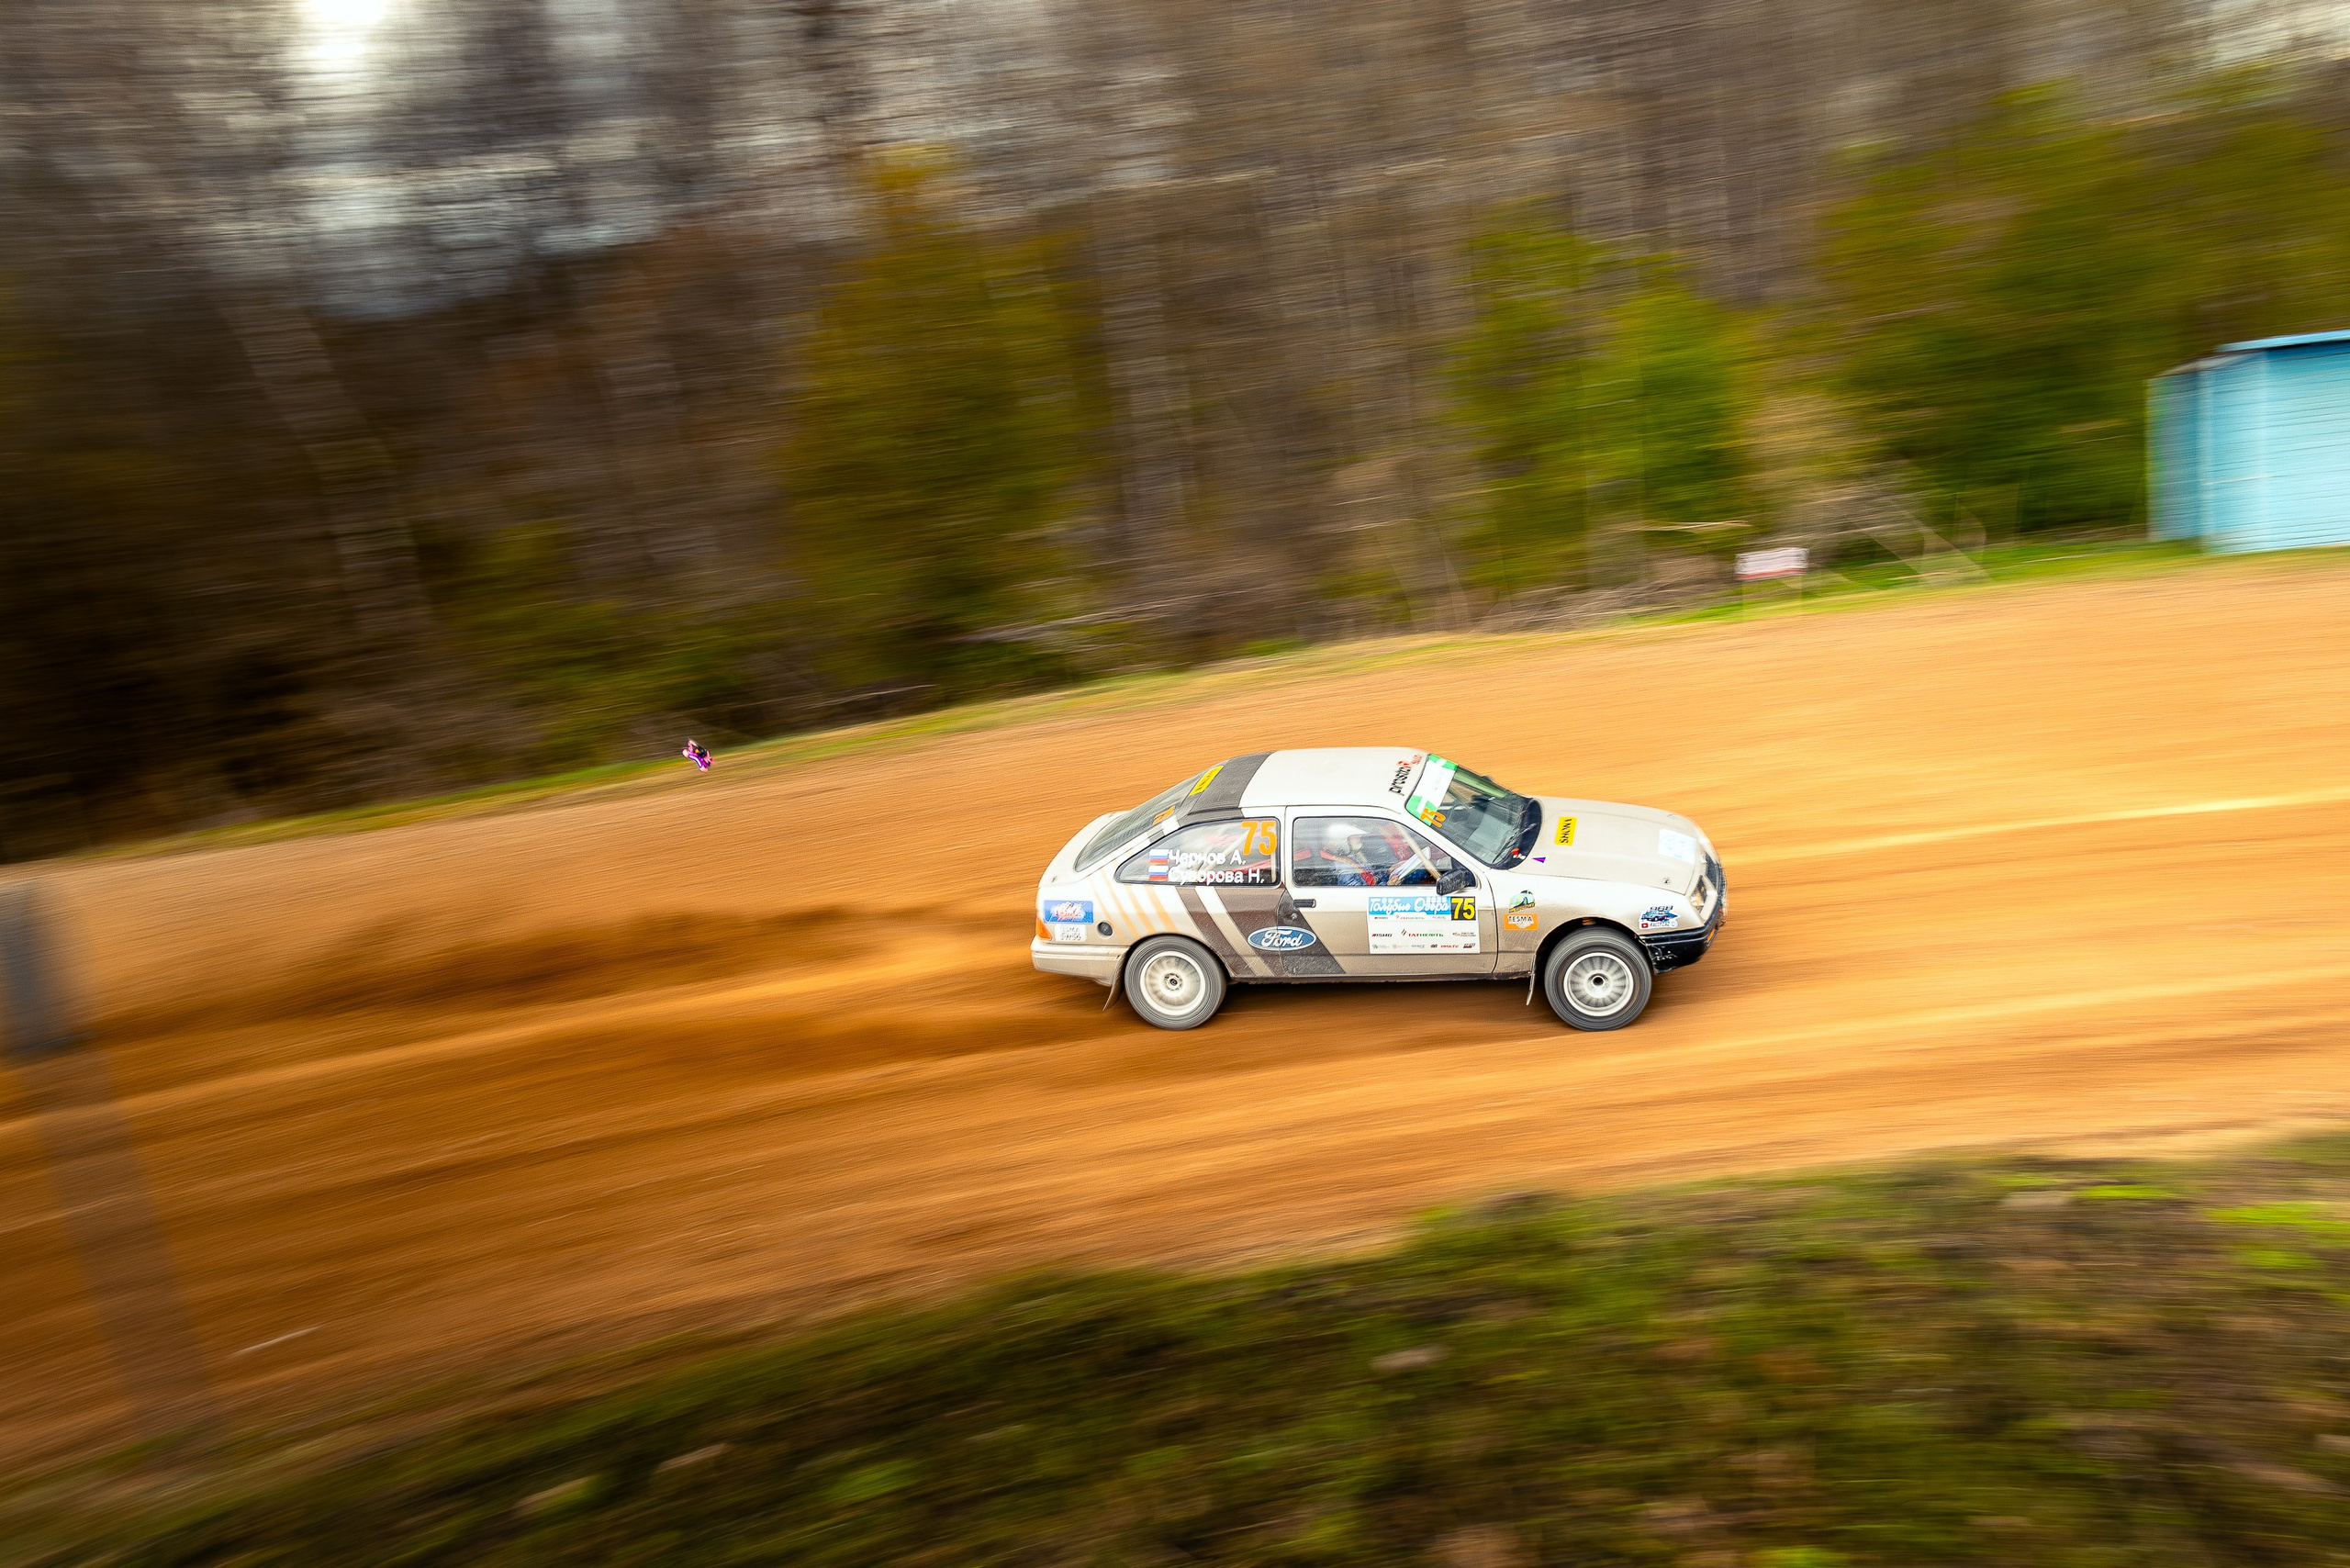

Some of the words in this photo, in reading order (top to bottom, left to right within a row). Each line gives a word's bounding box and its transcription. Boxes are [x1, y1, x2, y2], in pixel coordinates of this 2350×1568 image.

[1420, 807, 1446, 828] 75
[1241, 820, 1277, 856] 75
[1451, 897, 1475, 920] 75
[1261, 929, 1303, 946] Ford
